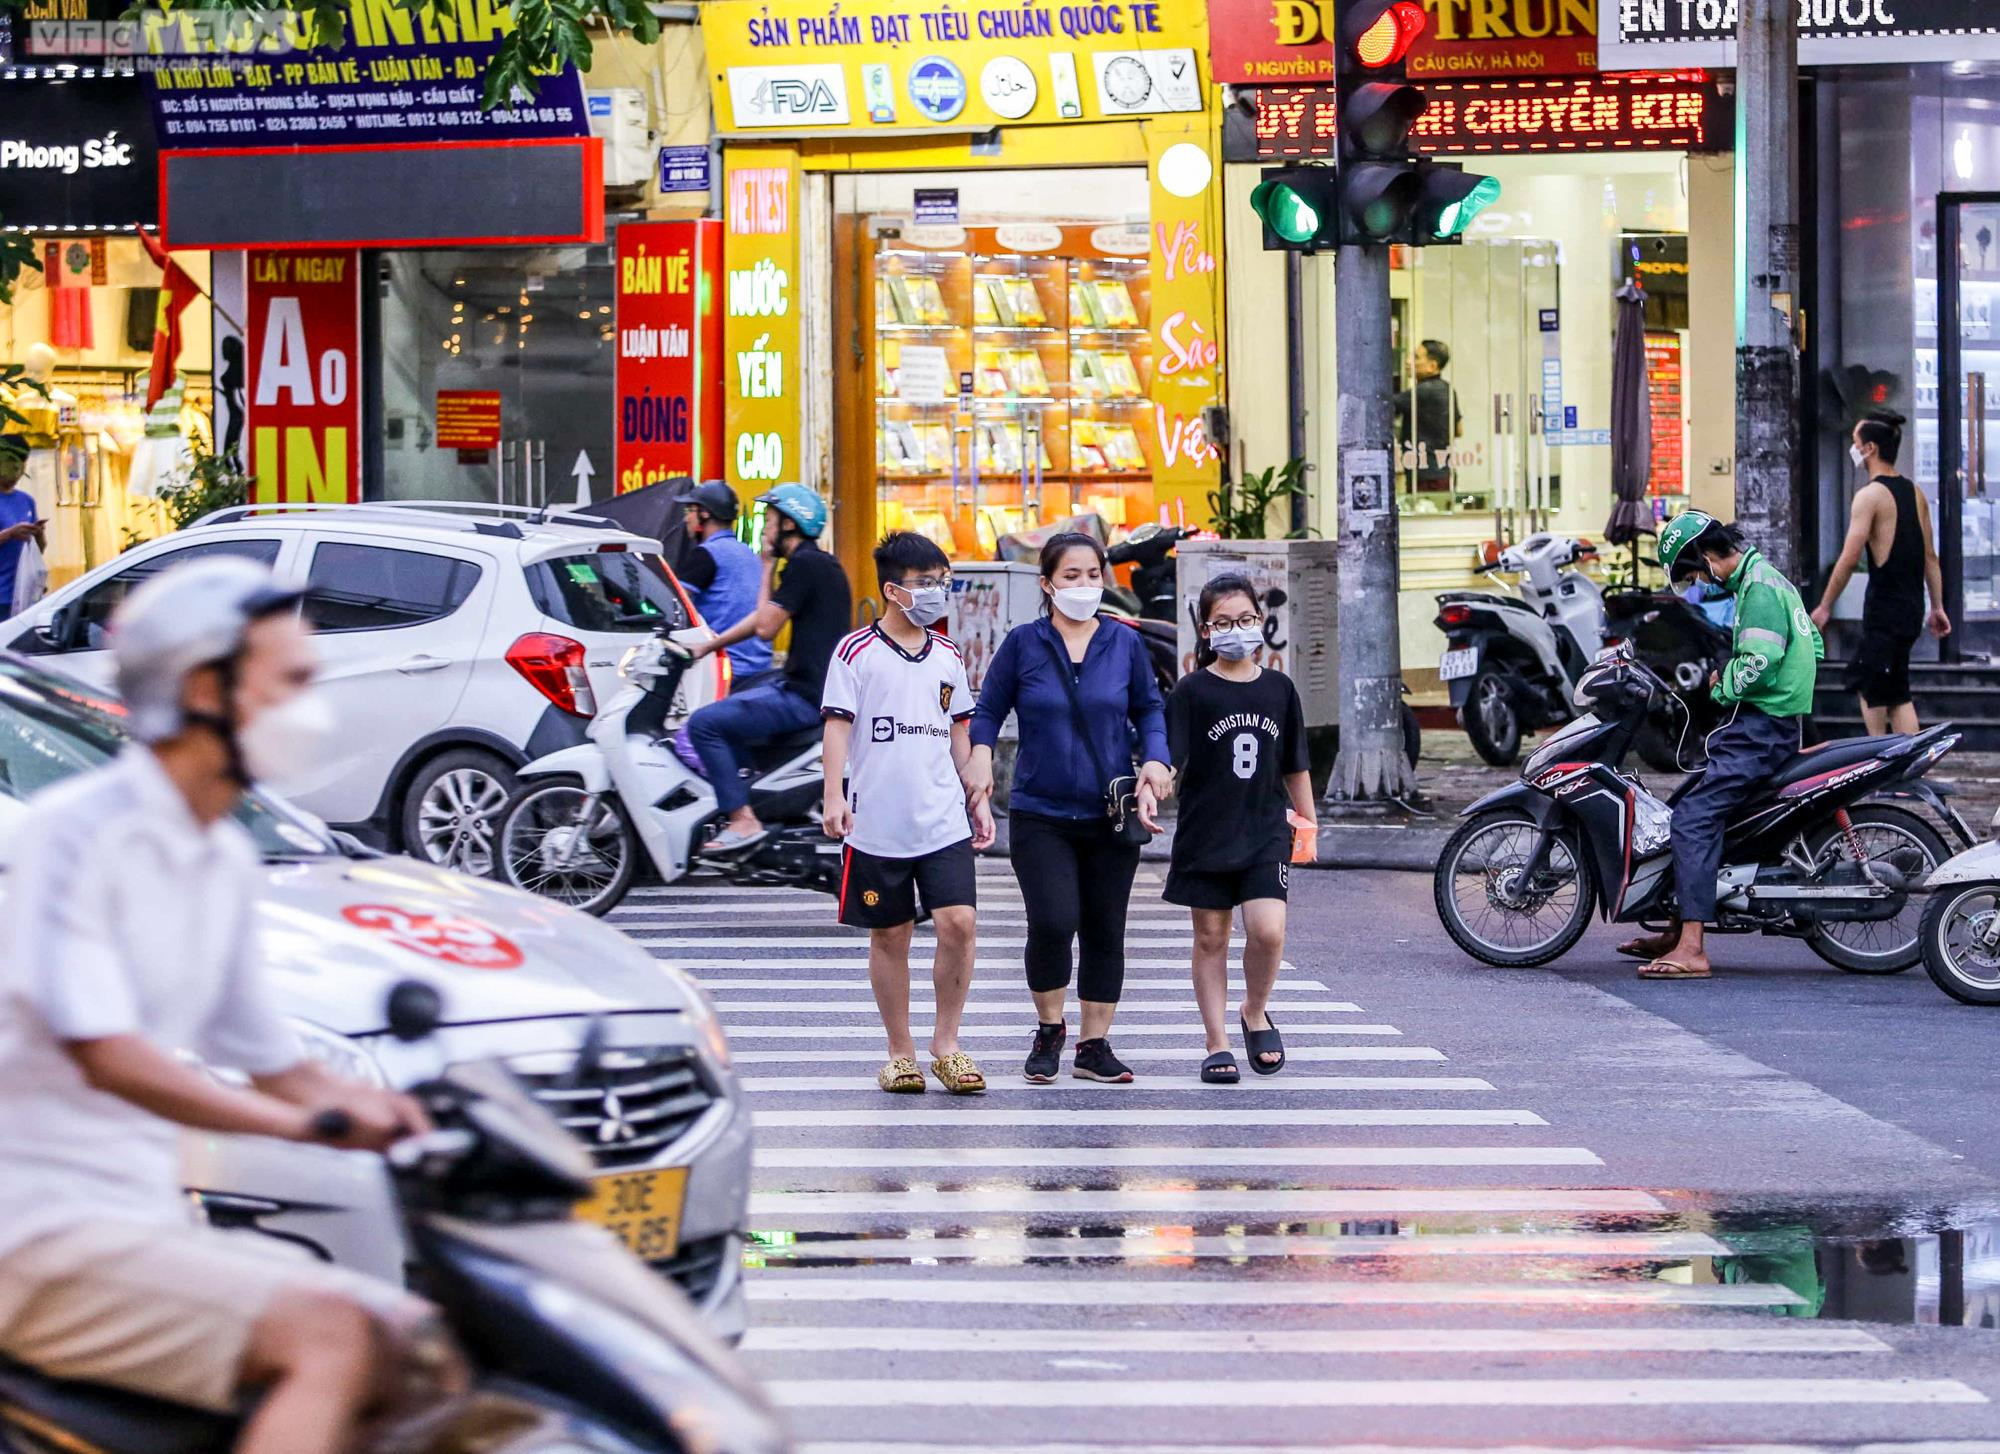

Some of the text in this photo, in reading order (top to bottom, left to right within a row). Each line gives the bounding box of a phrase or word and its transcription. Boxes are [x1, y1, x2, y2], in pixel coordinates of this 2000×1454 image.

[748, 6, 791, 47] SẢN
[797, 2, 862, 46] PHẨM
[872, 13, 911, 50] ĐẠT
[919, 3, 970, 41] TIÊU
[978, 0, 1055, 39] CHUẨN
[1243, 61, 1254, 76] 9
[1492, 51, 1517, 69] HÀ
[1519, 50, 1544, 69] NỘI
[255, 96, 294, 111] PHONG
[770, 78, 838, 115] FDA
[1463, 87, 1619, 134] CHUYÊN
[1, 130, 131, 175] Phong Sắc
[296, 257, 345, 283] NGAY
[622, 244, 690, 294] BẢN VẼ
[729, 258, 789, 317] NƯỚC
[621, 323, 690, 363] LUẬN VĂN
[737, 333, 783, 398] YẾN
[1158, 311, 1218, 377] Sào
[623, 386, 689, 443] ĐÓNG
[255, 427, 347, 513] IN
[736, 433, 783, 480] CAO
[1662, 528, 1682, 554] Grab
[1207, 713, 1260, 741] CHRISTIAN
[1233, 733, 1258, 779] 8
